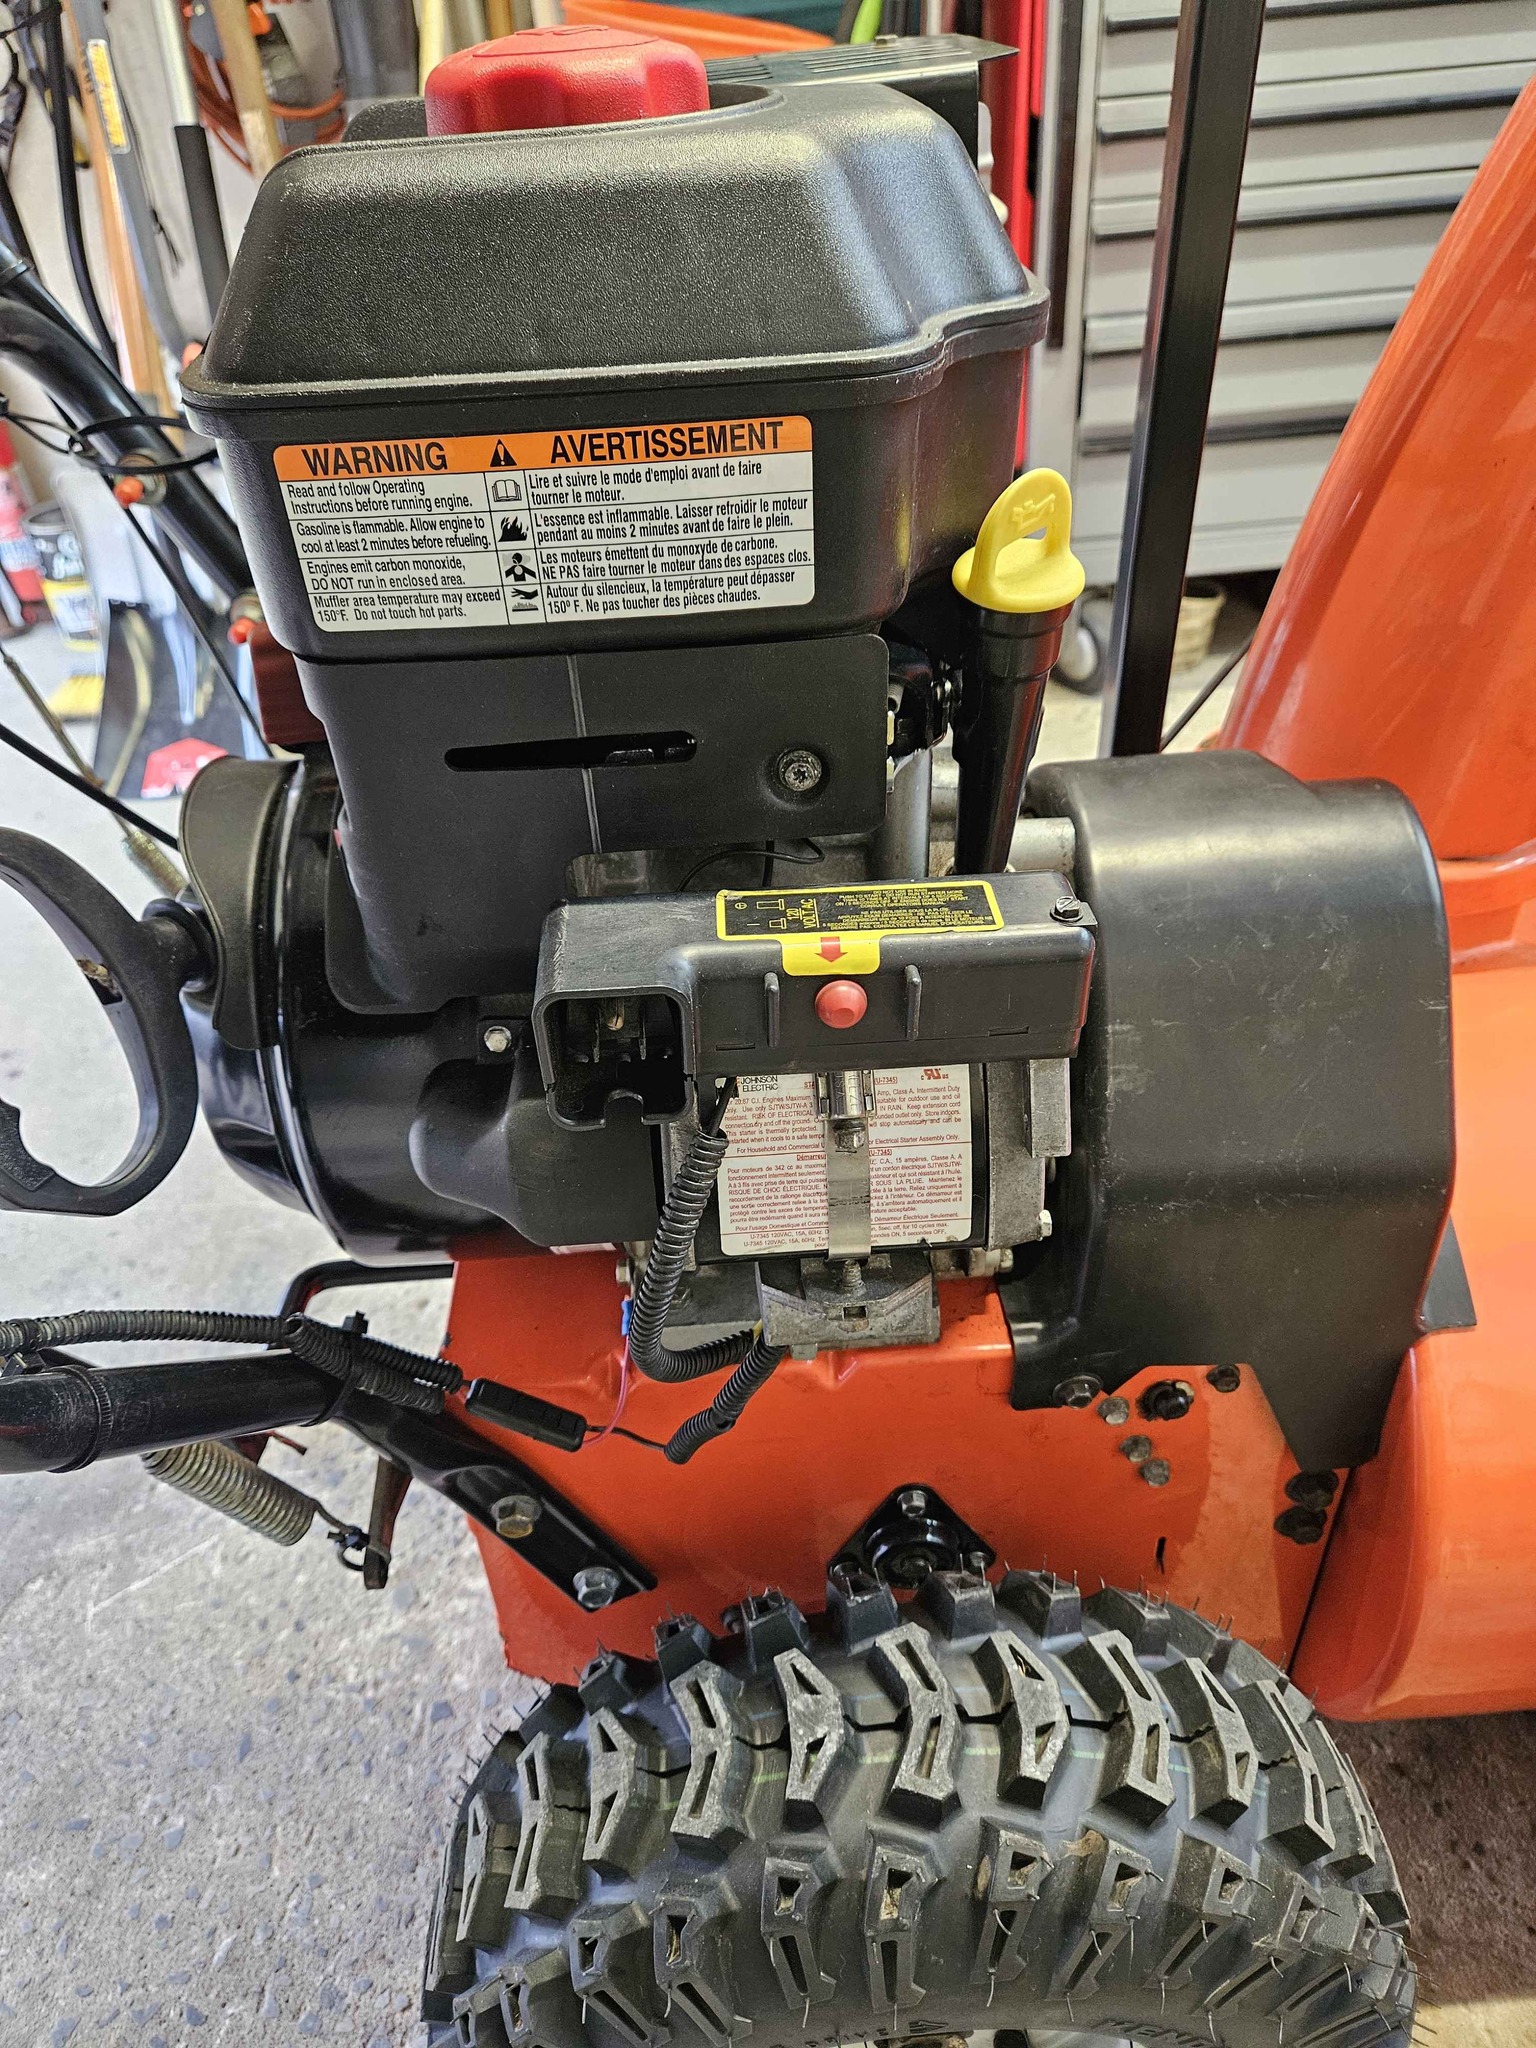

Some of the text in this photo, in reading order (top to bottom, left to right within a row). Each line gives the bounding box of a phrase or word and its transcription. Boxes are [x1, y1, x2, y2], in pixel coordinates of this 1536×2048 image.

[550, 421, 784, 464] AVERTISSEMENT
[301, 442, 448, 476] WARNING
[528, 460, 761, 489] Lire et suivre le mode d'emploi avant de faire
[287, 479, 425, 498] Read and follow Operating
[531, 489, 624, 506] tourner le moteur.
[291, 493, 472, 514] Instructions before running engine.
[534, 498, 807, 527] L'essence est inflammable. Laisser refroidir le moteur
[295, 515, 485, 535] Gasoline is flammable. Allow engine to
[537, 512, 792, 547] pendant au moins 2 minutes avant de faire le plein.
[300, 532, 491, 553] cool at least 2 minutes before refueling.
[539, 536, 777, 564] Les moteurs émettent du monoxyde de carbone.
[306, 555, 465, 577] Engines emit carbon monoxide,
[542, 549, 810, 580] NE PAS faire tourner le moteur dans des espaces clos.
[311, 572, 465, 591] DO NOT run in enclosed area.
[545, 570, 794, 598] Autour du silencieux, la température peut dépasser
[313, 587, 501, 608] Muffler area temperature may exceed
[573, 597, 583, 612] F.
[585, 596, 599, 611] Ne
[602, 598, 620, 614] pas
[622, 593, 660, 609] toucher
[662, 592, 680, 606] des
[683, 590, 714, 609] pièces
[717, 587, 760, 603] chaudes.
[353, 606, 368, 620] Do
[370, 607, 387, 620] not
[388, 604, 417, 619] touch
[418, 604, 435, 618] hot
[437, 604, 466, 621] parts.
[786, 908, 799, 920] 120
[800, 898, 816, 928] VOLT AC
[741, 1075, 778, 1084] JOHNSON
[742, 1084, 779, 1092] ELECTRIC
[777, 1110, 814, 1118] ELECTRICAL
[746, 1145, 775, 1153] Household
[918, 1134, 944, 1142] Assembly
[945, 1133, 960, 1142] Only.
[782, 1184, 821, 1192] ÉLECTRIQUE.
